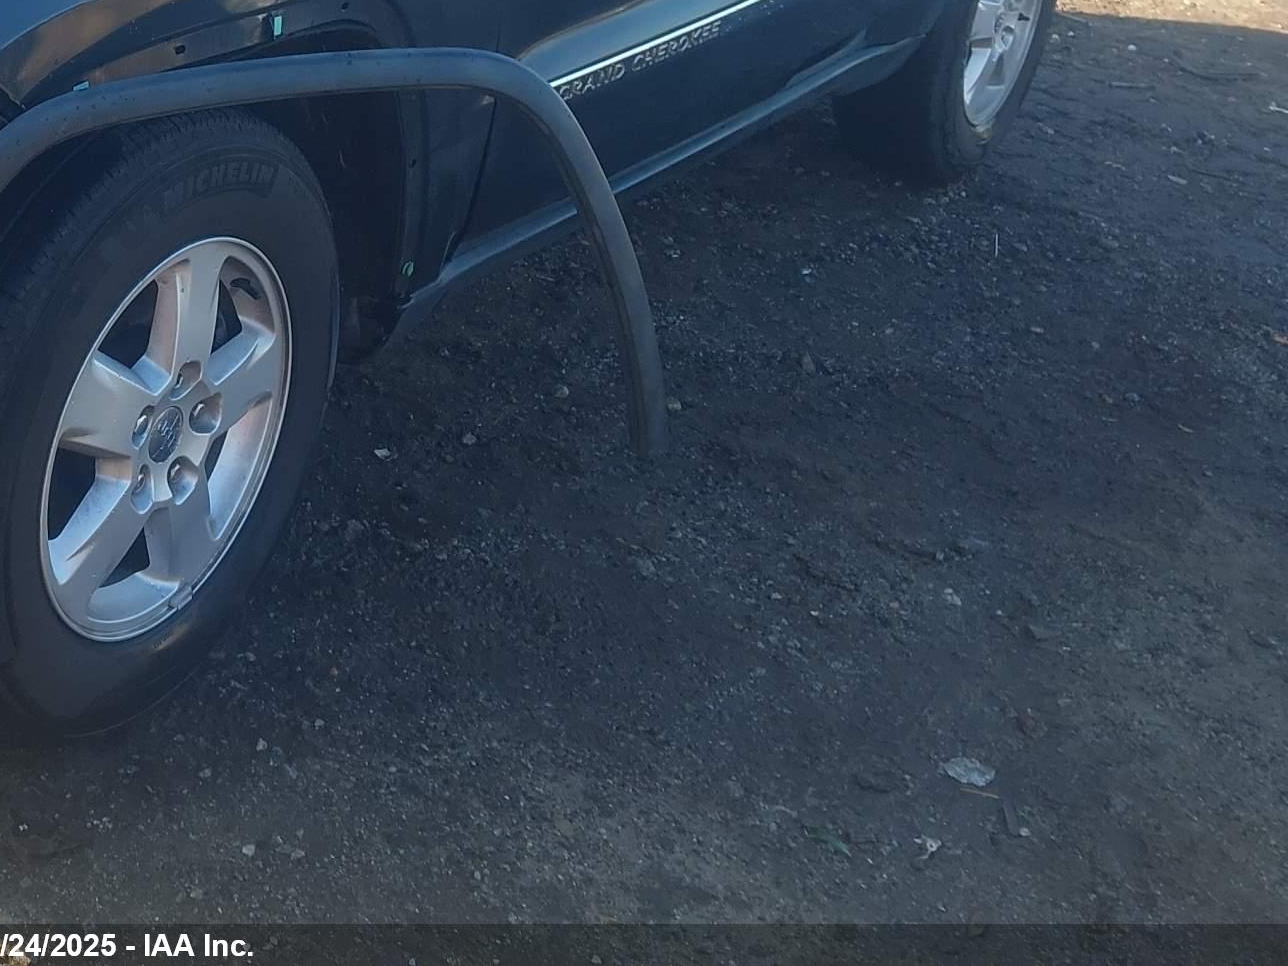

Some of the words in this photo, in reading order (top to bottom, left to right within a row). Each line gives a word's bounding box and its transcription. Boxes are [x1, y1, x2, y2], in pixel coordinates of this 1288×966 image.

[559, 63, 626, 101] GRAND
[631, 19, 722, 72] CHEROKEE
[162, 160, 276, 213] MICHELIN
